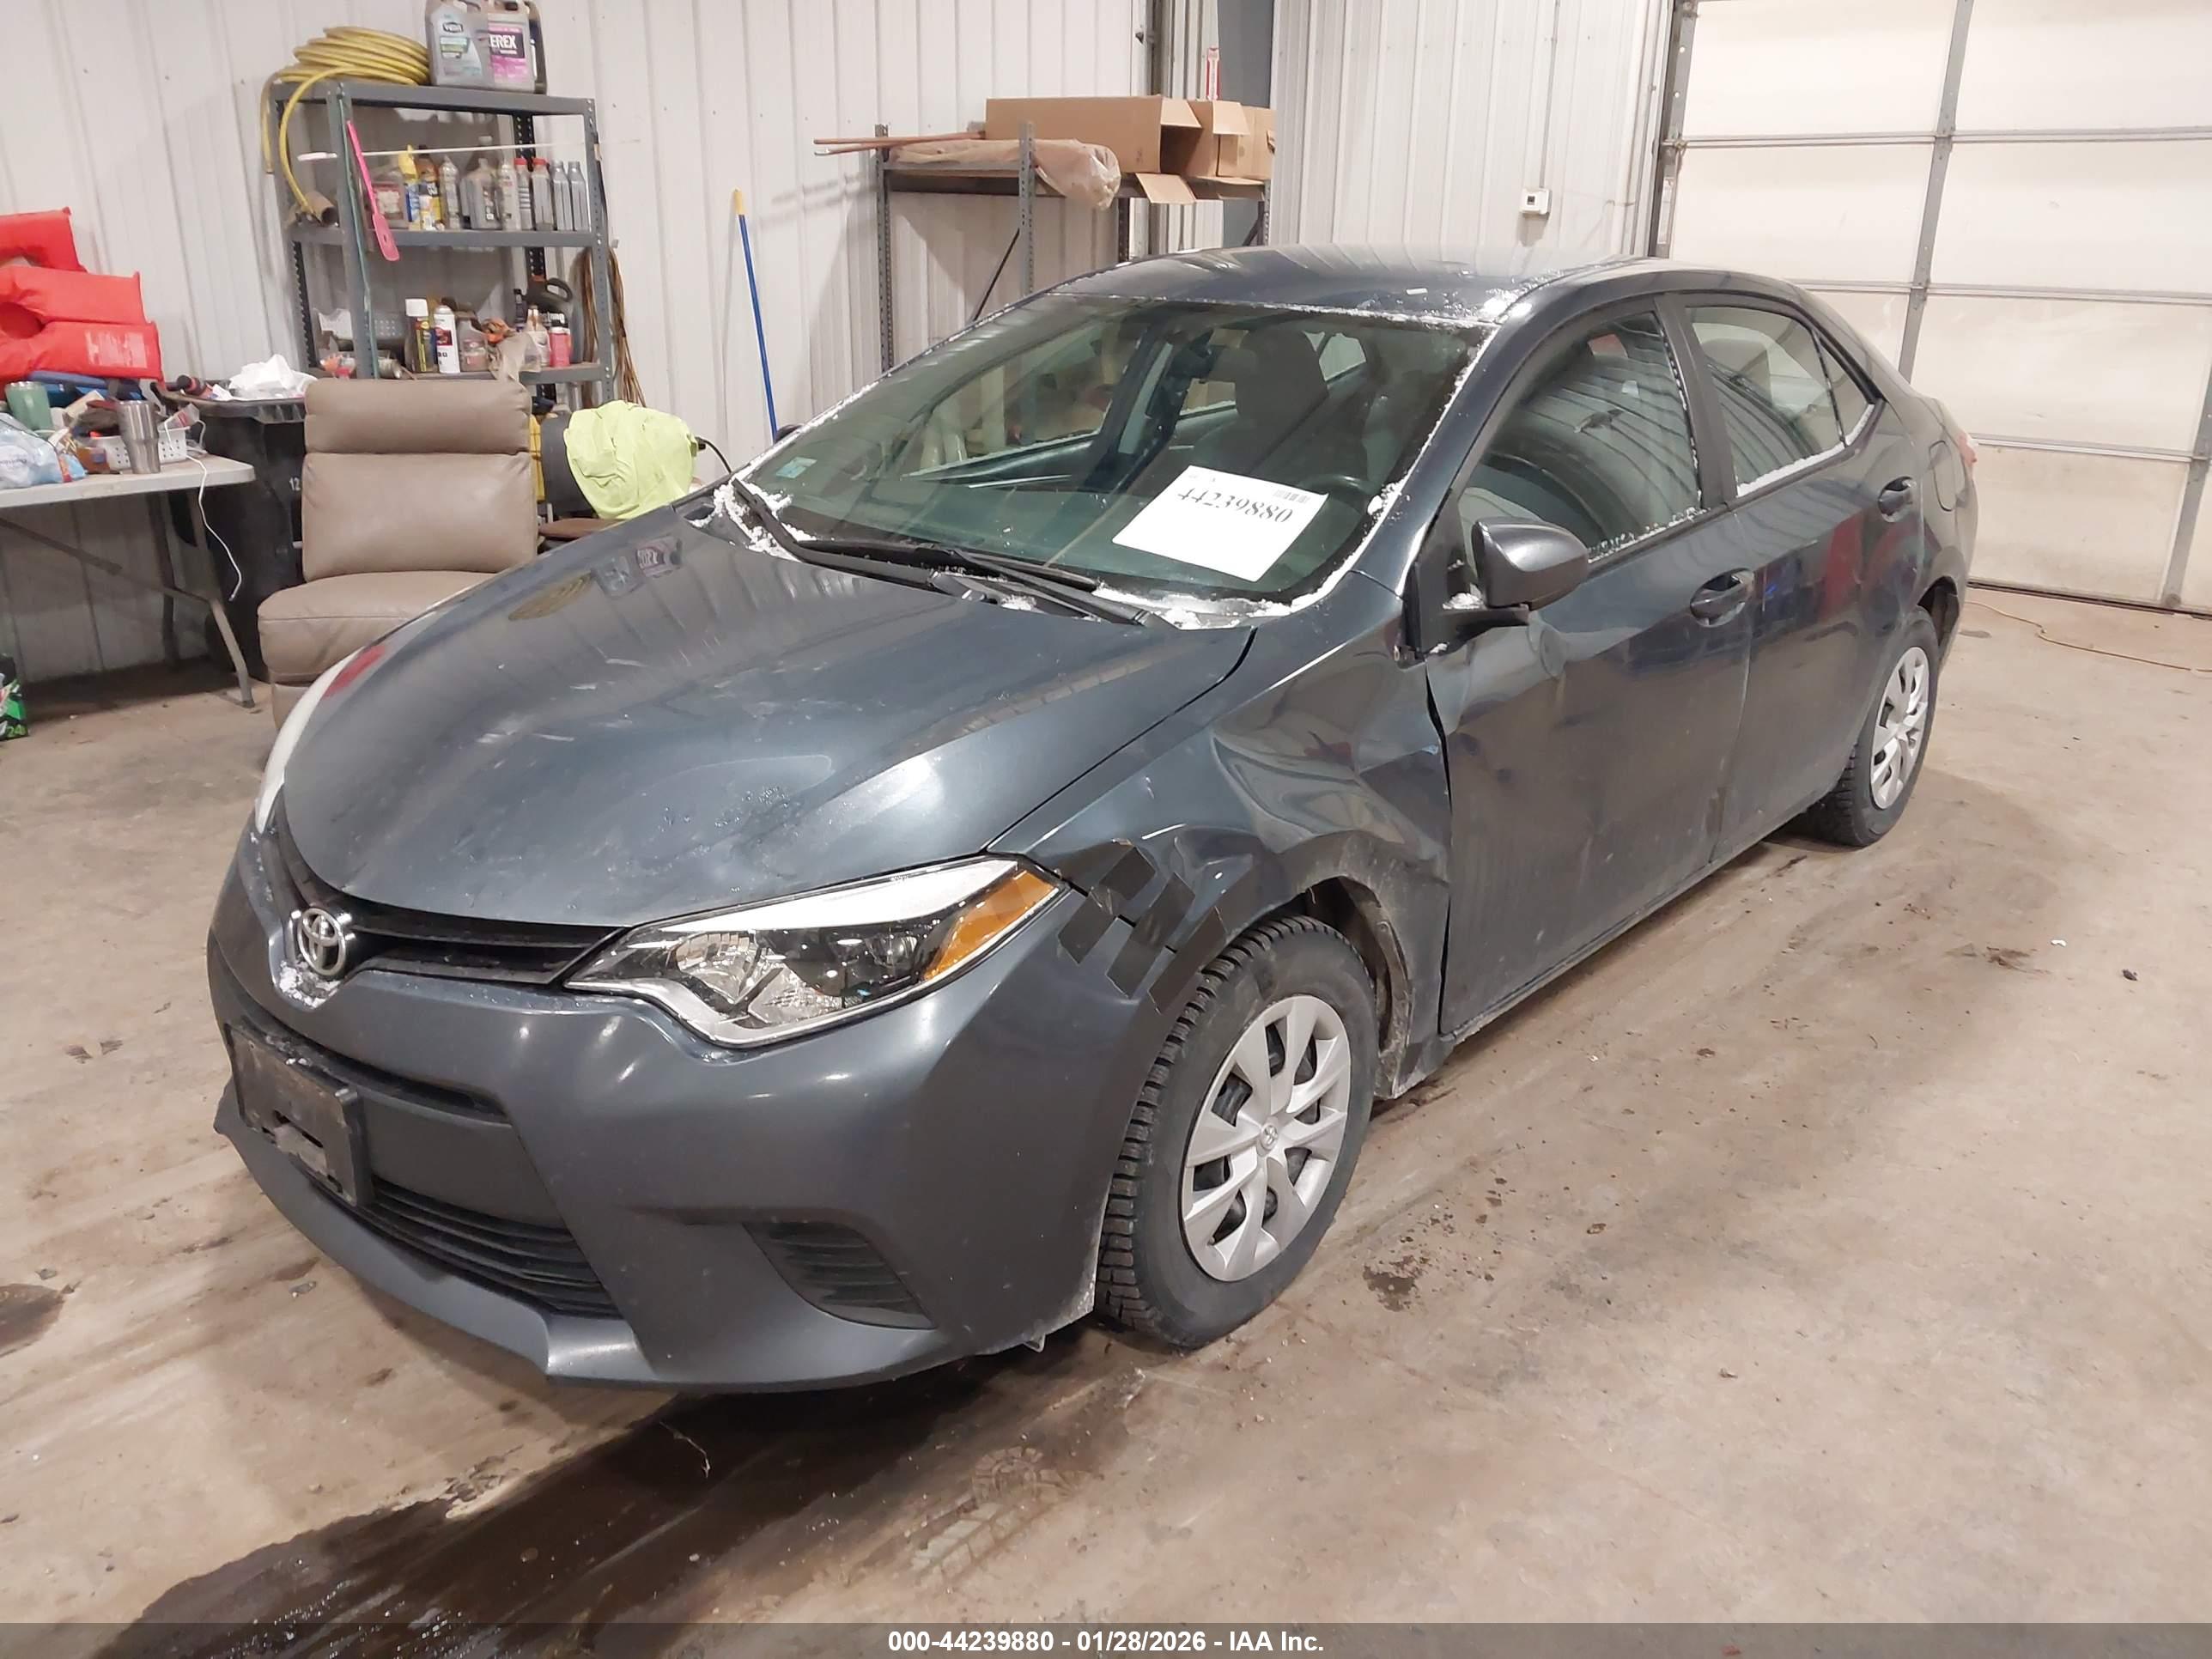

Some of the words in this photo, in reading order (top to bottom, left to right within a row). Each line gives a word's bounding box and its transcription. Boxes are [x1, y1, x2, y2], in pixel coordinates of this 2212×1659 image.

[488, 33, 518, 50] EREX
[289, 477, 301, 491] 12
[1176, 487, 1294, 523] 44239880
